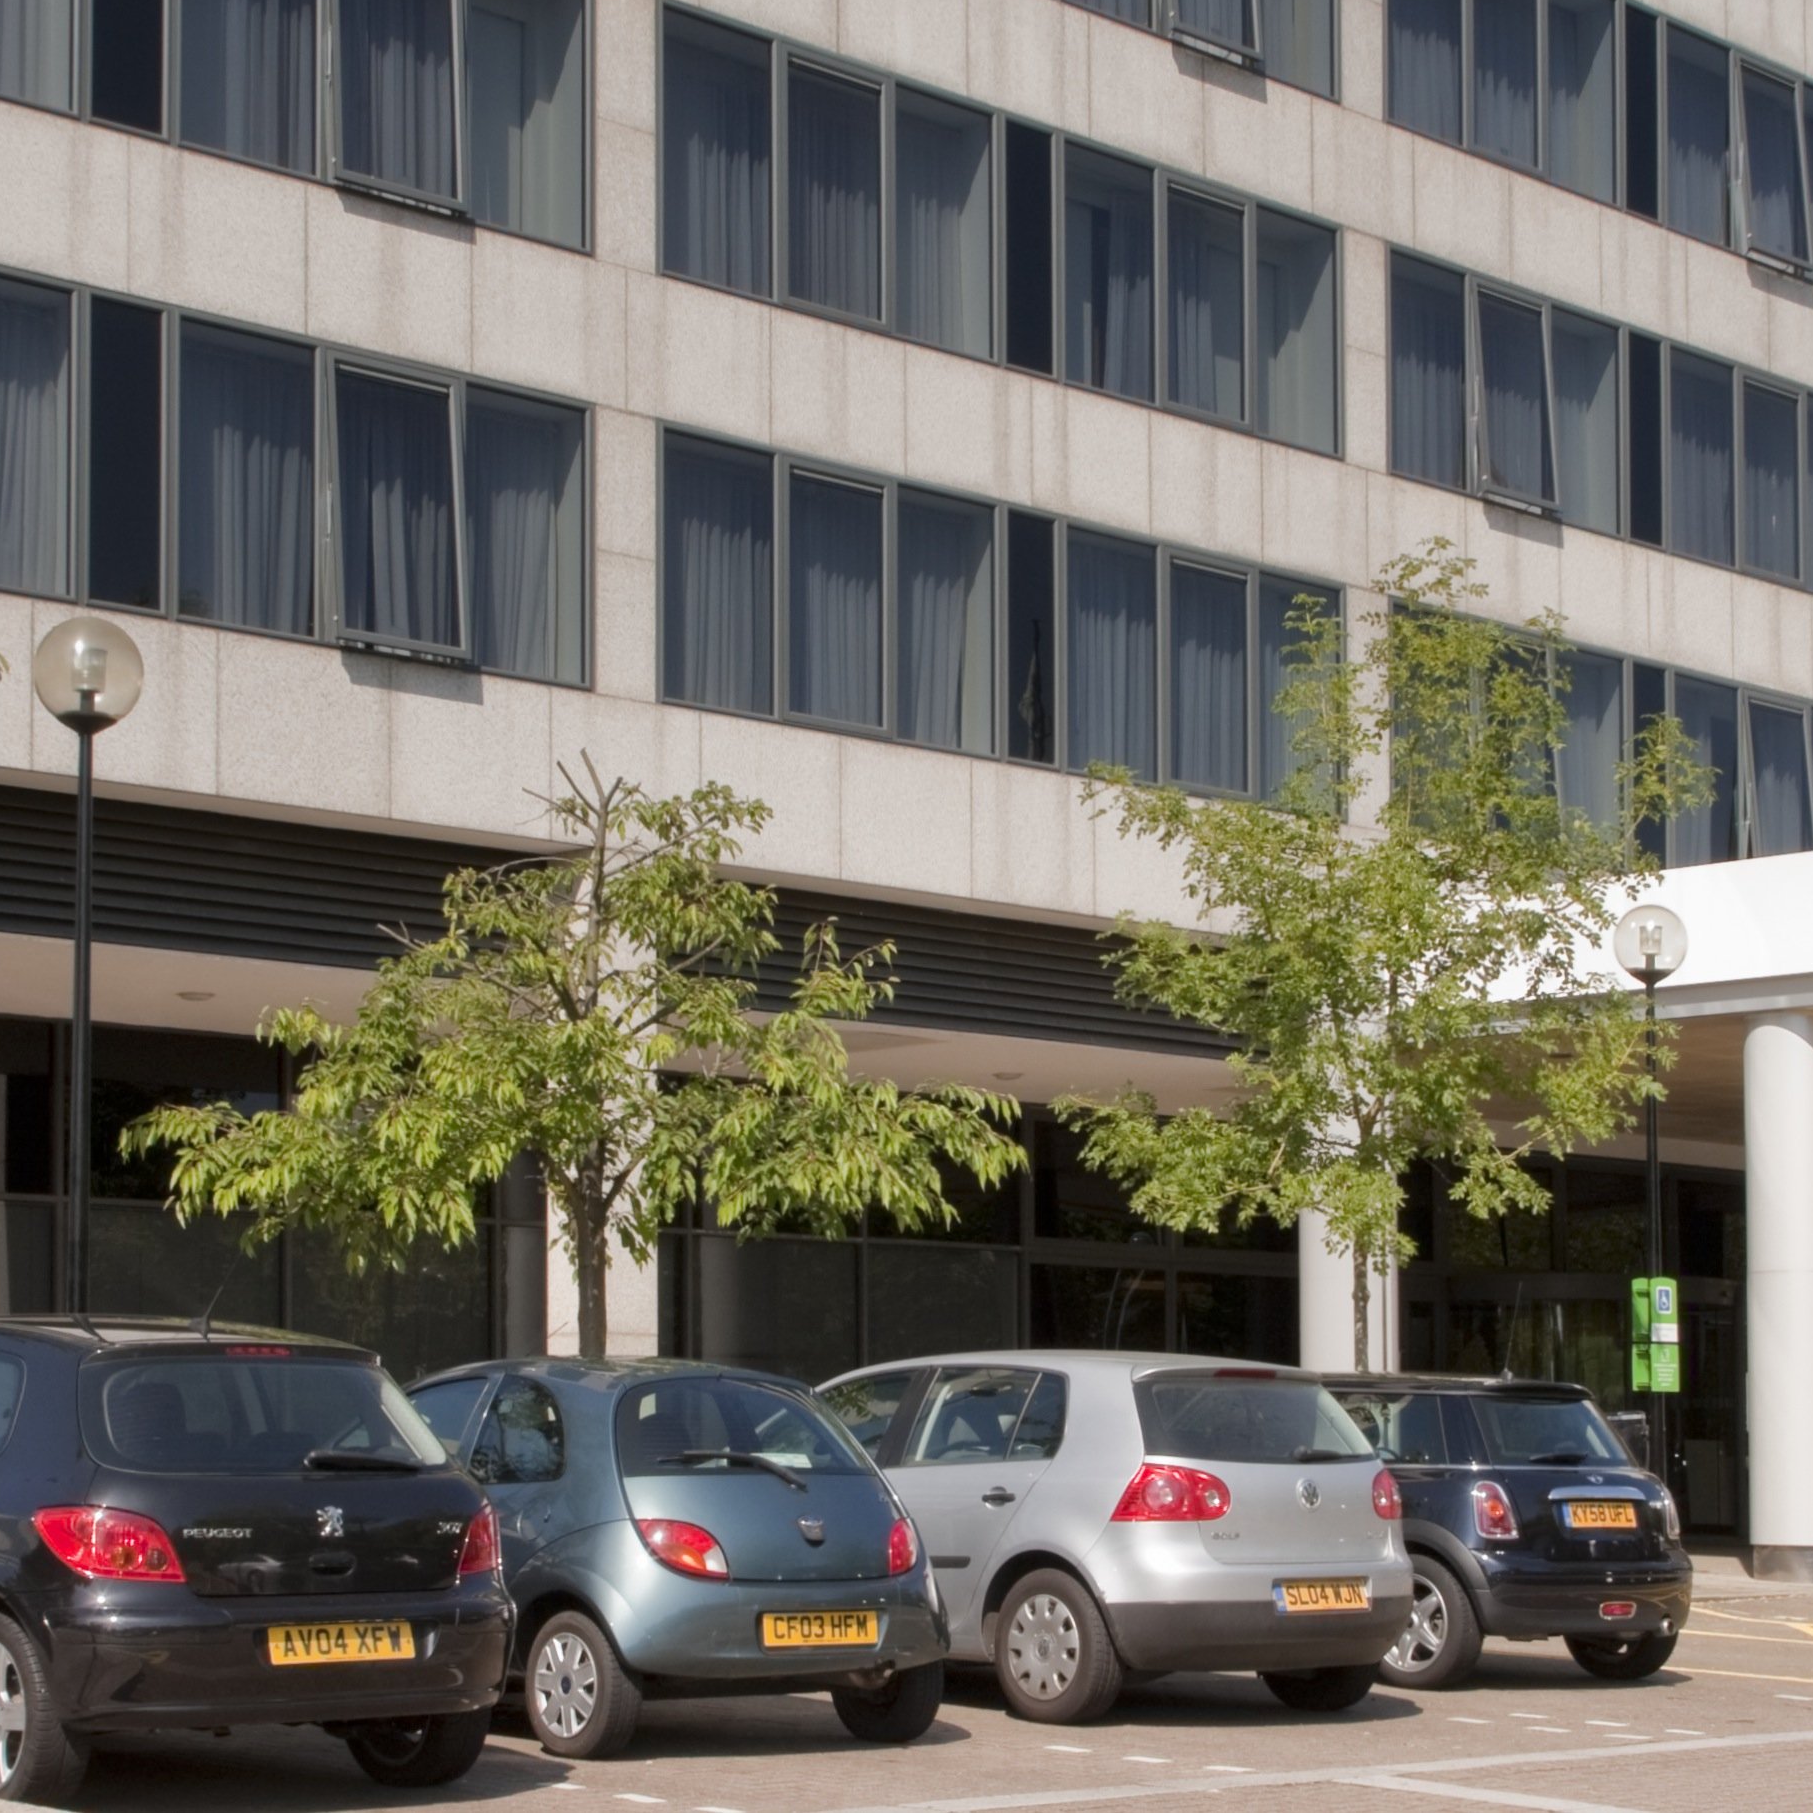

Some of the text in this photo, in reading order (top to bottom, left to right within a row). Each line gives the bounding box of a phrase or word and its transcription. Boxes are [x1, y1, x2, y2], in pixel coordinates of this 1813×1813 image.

[1571, 1504, 1634, 1523] KY58 UFL
[183, 1528, 253, 1538] PEUGEOT
[437, 1521, 463, 1534] 307
[1287, 1584, 1364, 1606] SL04 WJN
[773, 1614, 869, 1639] CF03 HFM
[283, 1625, 403, 1658] AV04 XFW
